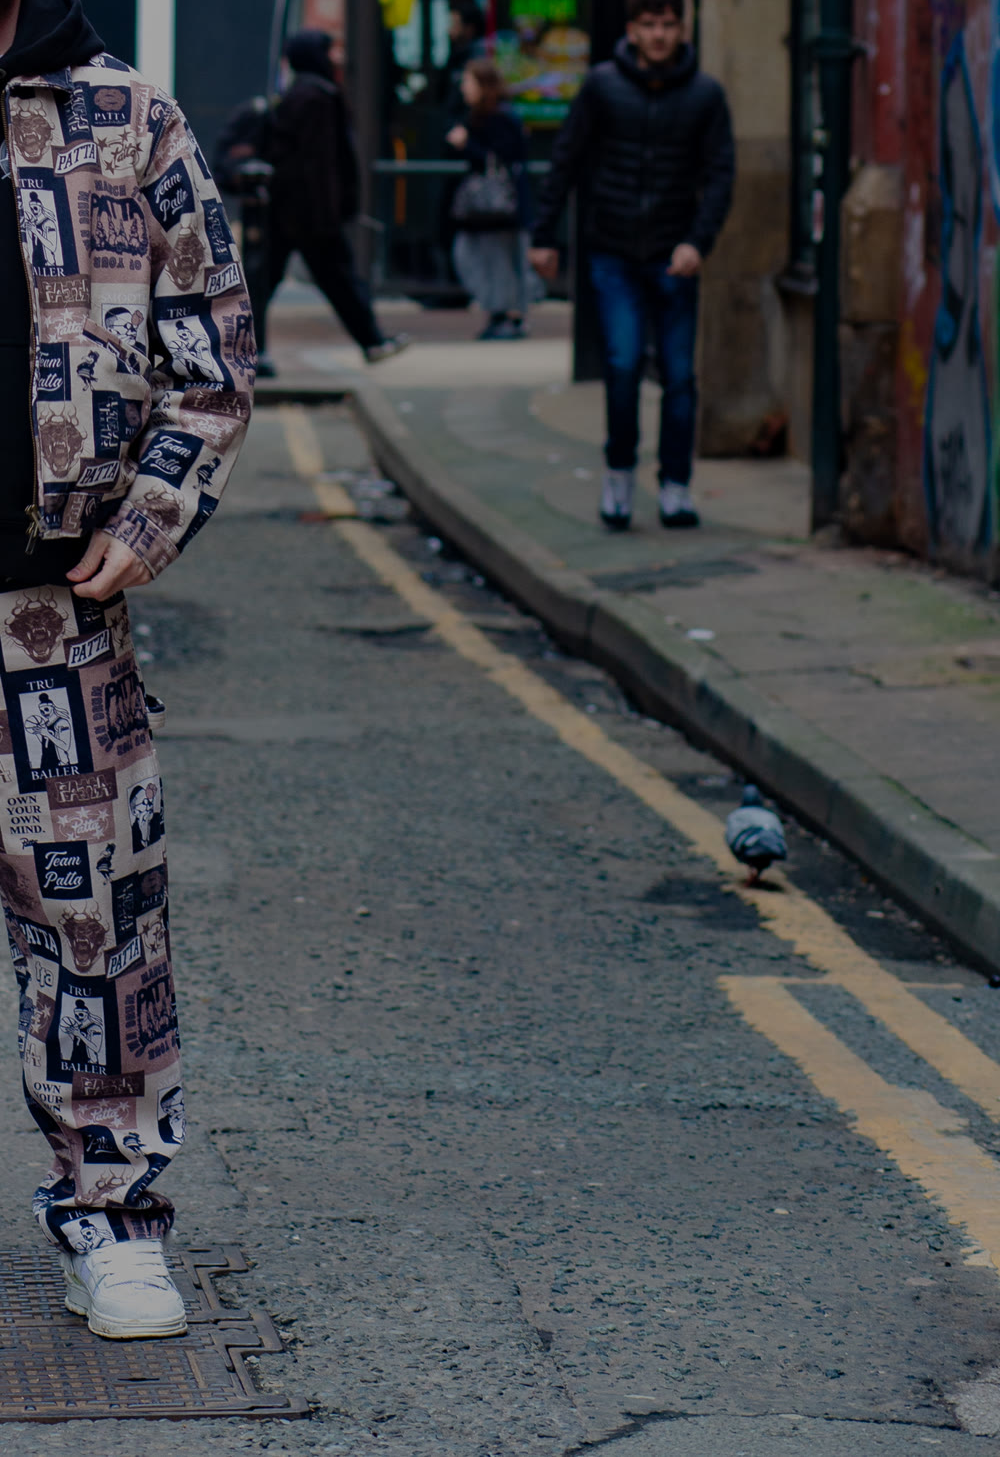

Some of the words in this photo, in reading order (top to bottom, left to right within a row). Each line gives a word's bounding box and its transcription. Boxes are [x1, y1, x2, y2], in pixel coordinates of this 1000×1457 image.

[94, 112, 126, 121] PATTA
[57, 143, 96, 171] PATTA
[19, 178, 44, 189] TRU
[154, 172, 182, 204] Team
[33, 267, 66, 278] ALLER
[208, 264, 239, 294] PATTA
[167, 305, 192, 319] TRU
[38, 372, 63, 391] atta
[154, 435, 192, 458] Team
[141, 449, 182, 475] Patta
[81, 462, 118, 484] PATTA
[71, 630, 110, 665] PATTA
[26, 678, 55, 691] TRU
[31, 765, 80, 781] BALLER
[7, 795, 37, 806] OWN
[7, 805, 41, 816] YOUR
[11, 816, 41, 825] OWN
[10, 825, 46, 835] MIND.
[44, 850, 82, 870] Team
[43, 870, 84, 890] Patta
[109, 937, 140, 976] PATTA
[68, 984, 92, 997] TRU
[60, 1061, 107, 1076] BALLER
[34, 1081, 61, 1094] OWN
